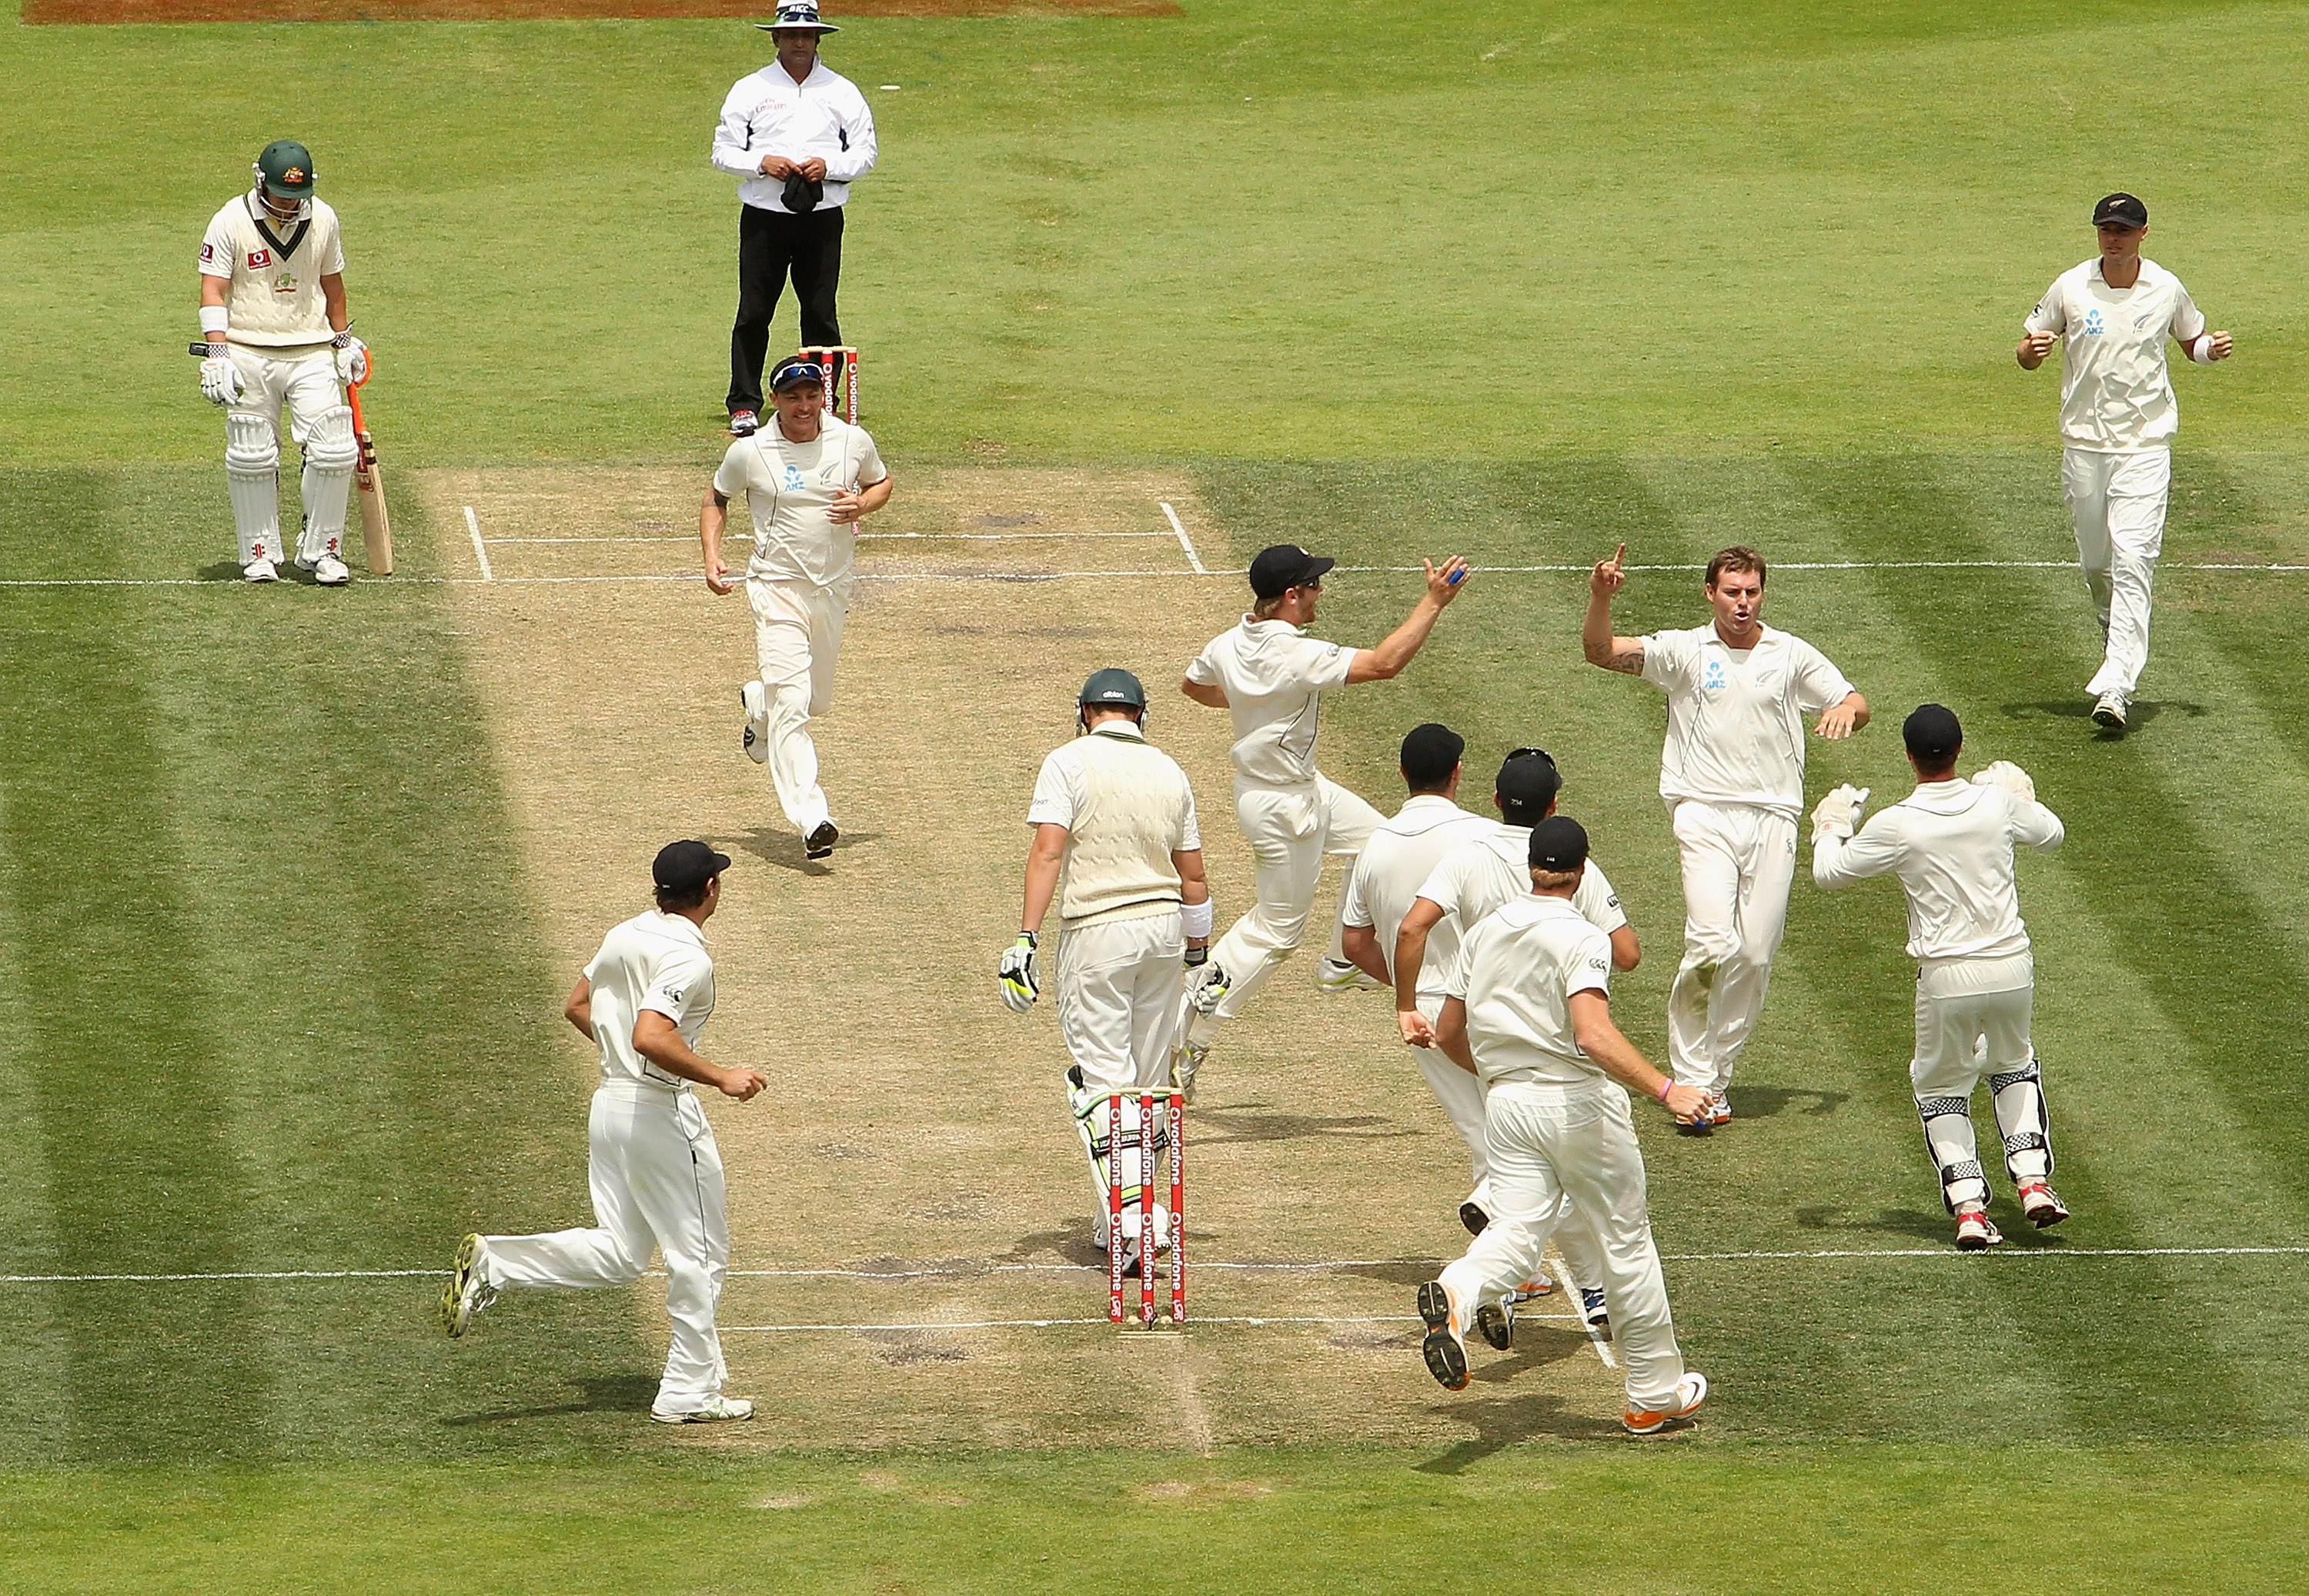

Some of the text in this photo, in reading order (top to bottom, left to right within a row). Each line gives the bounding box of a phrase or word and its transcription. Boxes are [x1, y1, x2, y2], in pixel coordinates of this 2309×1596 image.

[2084, 326, 2104, 335] ANZ
[824, 374, 834, 416] vodafo
[784, 481, 805, 492] ANZ
[1704, 679, 1726, 689] ANZ
[1111, 1122, 1122, 1186] vodafone
[1142, 1122, 1153, 1186] vodafone
[1171, 1121, 1182, 1185] vodafone
[1112, 1227, 1123, 1291] vodafone
[1143, 1227, 1154, 1291] vodafone
[1171, 1227, 1183, 1290] vodafone
